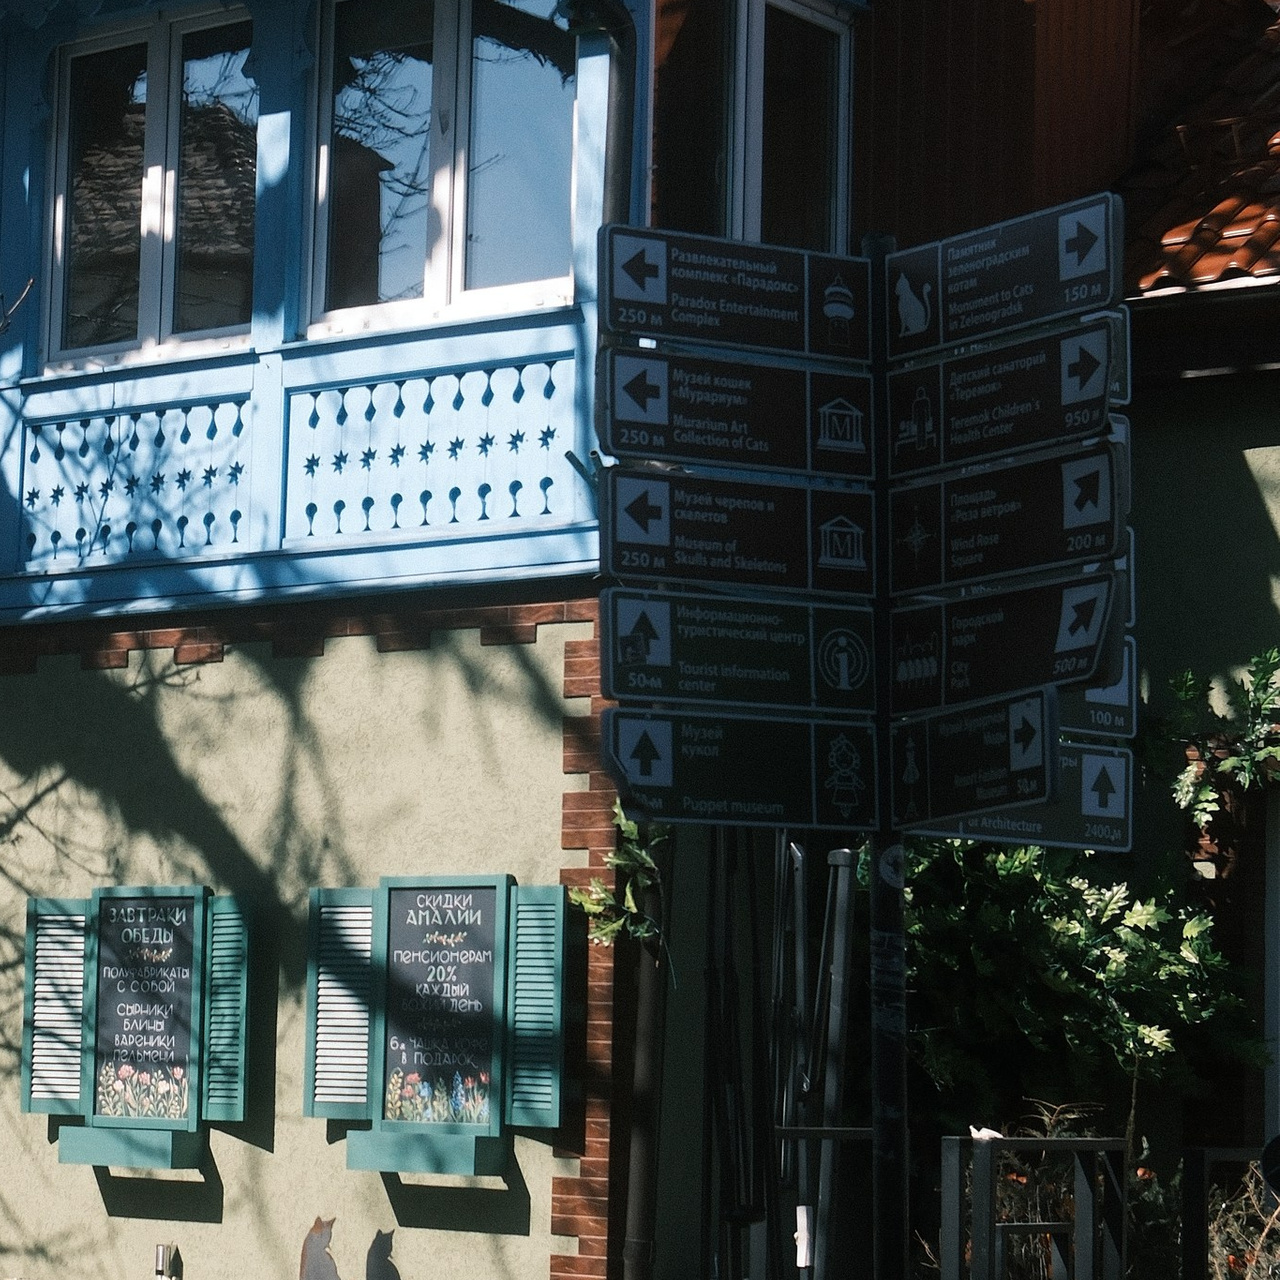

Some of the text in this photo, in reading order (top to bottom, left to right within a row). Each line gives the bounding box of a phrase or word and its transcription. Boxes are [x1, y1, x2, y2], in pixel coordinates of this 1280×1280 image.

[947, 238, 997, 263] Памятник
[671, 247, 777, 275] Развлекательный
[948, 245, 1030, 279] зеленоградским
[671, 267, 800, 295] комплекс «Парадокс»
[948, 276, 978, 295] котам
[948, 282, 1035, 316] Monument to Cats
[1064, 284, 1089, 304] 150
[618, 307, 647, 324] 250
[671, 292, 799, 322] Paradox Entertainment
[959, 301, 1024, 331] Zelenogradsk
[671, 308, 721, 329] Complex
[949, 349, 1047, 389] Детский санаторий
[673, 367, 752, 391] Музей кошек
[672, 413, 749, 435] Murarium Art
[949, 409, 991, 430] Teremok
[1064, 410, 1090, 429] 950
[620, 428, 649, 446] 250
[673, 429, 770, 452] Collection of Cats
[949, 426, 982, 446] Health
[673, 488, 713, 508] Музей
[714, 496, 765, 514] черепов
[673, 508, 728, 526] скелетов
[674, 534, 737, 553] Museum of
[950, 531, 1000, 552] Wind Rose
[1065, 533, 1092, 553] 200
[621, 549, 651, 569] 250
[674, 550, 788, 575] Skulls and Skeletons
[951, 551, 985, 570] Square
[677, 623, 806, 647] туристический центр
[678, 660, 791, 682] Tourist information
[1052, 656, 1076, 676] 500
[628, 672, 648, 689] 50
[677, 679, 717, 693] center
[1090, 710, 1113, 727] 100
[681, 723, 723, 742] Музей
[681, 744, 721, 759] кукол
[683, 797, 785, 815] Puppet museum
[980, 815, 1043, 834] Architecture
[1084, 823, 1111, 839] 2400
[416, 893, 473, 911] СКИДКИ
[108, 906, 188, 926] ЗАВТРАКИ
[405, 909, 482, 925] АМАЛИИ
[120, 927, 175, 945] ОБЕДЫ
[393, 950, 492, 964] ПЕНСИОНЕРАМ
[102, 966, 191, 981] ПОЛУФАБРИКАТЫ
[426, 965, 458, 983] 20%
[116, 980, 126, 993] С
[415, 982, 470, 998] КАЖДЫЙ
[116, 1002, 175, 1019] СЫРНИКИ
[449, 998, 483, 1013] ДЕНЬ
[122, 1018, 165, 1032] БЛИНЫ
[114, 1033, 176, 1051] ВАРЕНИКИ
[409, 1036, 449, 1053] ЧАШКА
[113, 1048, 175, 1063] ПЕЛЬМЕНИ
[401, 1051, 480, 1069] В ПОДАРОК
